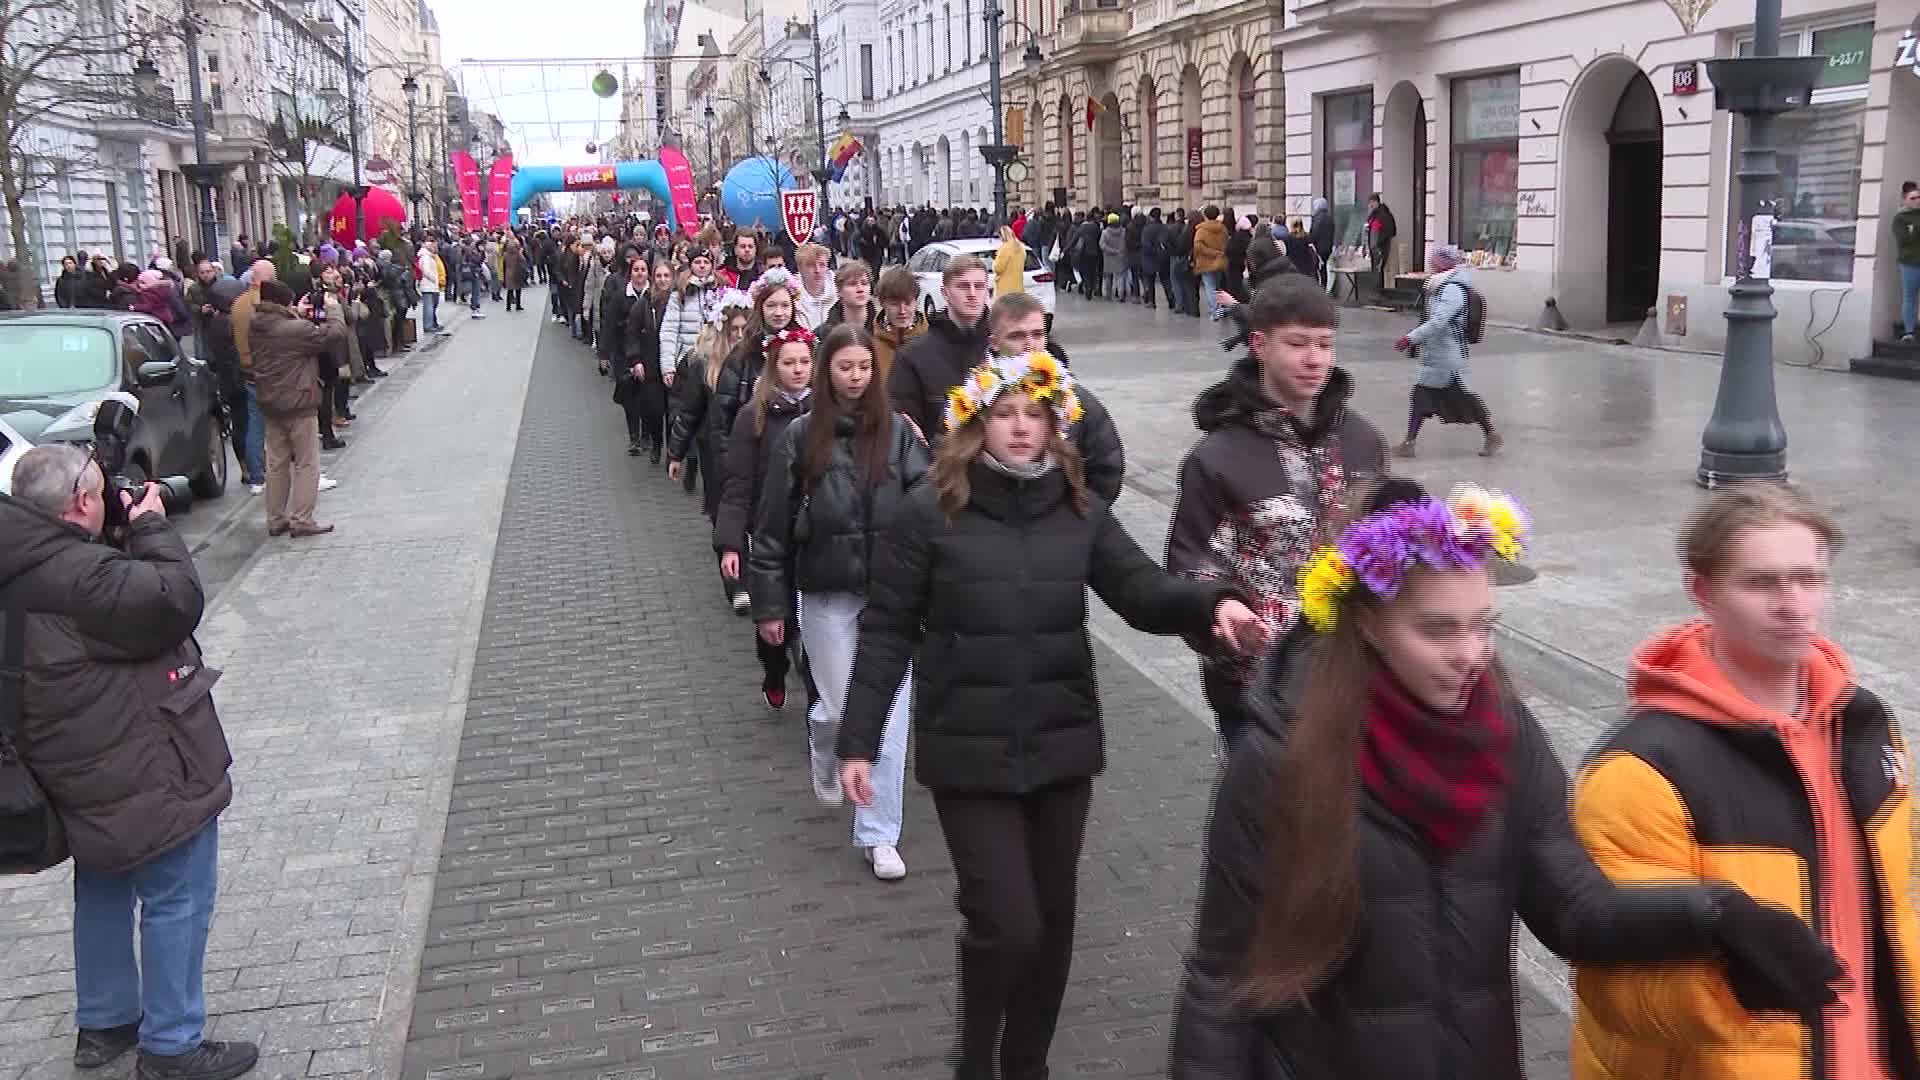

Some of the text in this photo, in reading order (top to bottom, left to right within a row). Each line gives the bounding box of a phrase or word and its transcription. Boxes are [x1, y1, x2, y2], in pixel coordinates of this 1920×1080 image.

[1675, 70, 1692, 87] 108
[787, 194, 813, 215] XXX
[794, 215, 809, 236] LO
